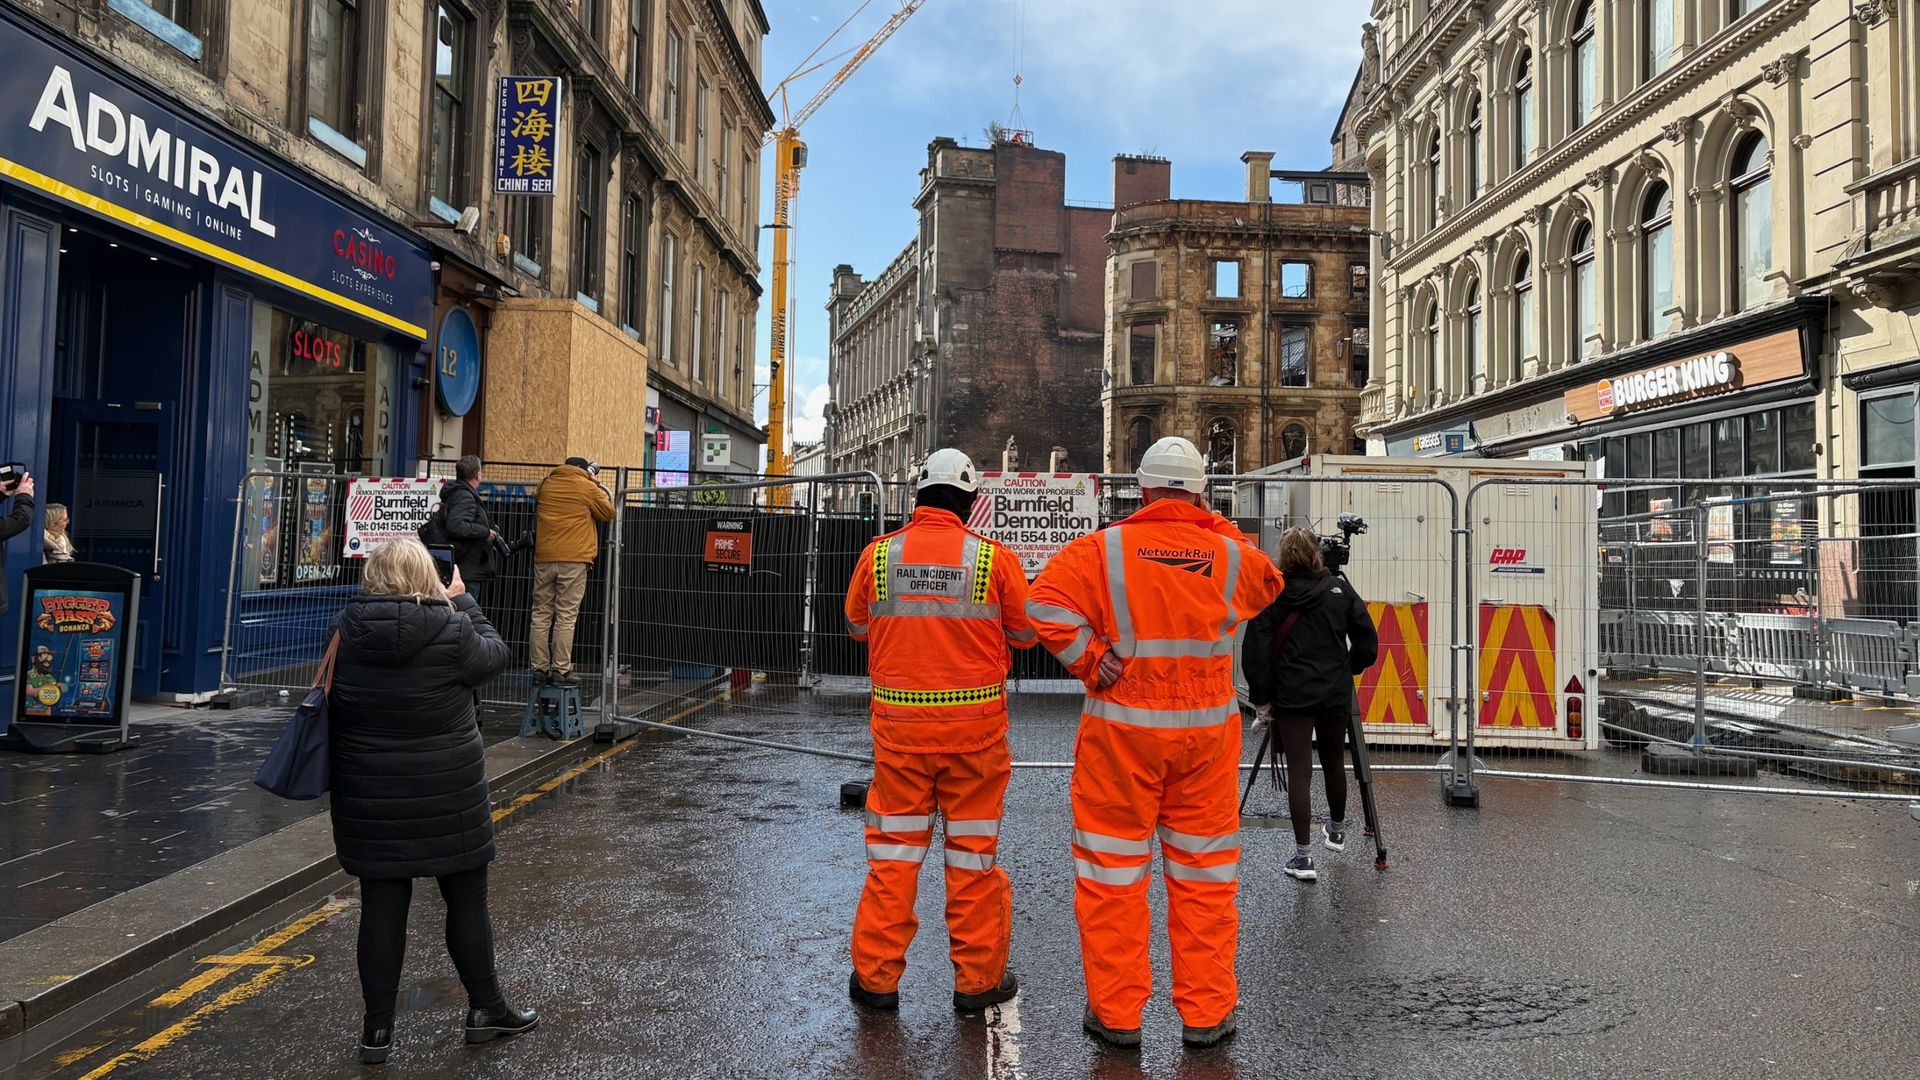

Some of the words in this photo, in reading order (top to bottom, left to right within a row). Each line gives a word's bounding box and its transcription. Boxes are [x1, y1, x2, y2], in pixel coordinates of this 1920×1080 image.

[499, 79, 507, 176] RESTAURANT
[509, 79, 553, 177] 四海楼
[28, 65, 276, 238] ADMIRAL
[498, 178, 528, 191] CHINA
[532, 178, 552, 191] SEA
[90, 164, 129, 192] SLOTS
[144, 189, 192, 219] GAMING
[205, 215, 242, 241] ONLINE
[332, 229, 397, 280] CASINO
[332, 270, 353, 288] SLOTS
[355, 280, 393, 305] EXPERIENCE
[293, 330, 341, 368] SLOTS
[441, 346, 457, 377] 12
[1613, 365, 1680, 407] BURGER
[1680, 352, 1730, 392] KING
[1418, 431, 1441, 449] GREGGS
[1004, 479, 1047, 487] CAUTION
[978, 487, 1012, 495] OLITION
[374, 496, 428, 508] Burnfield
[994, 495, 1074, 512] Burnfield
[374, 508, 432, 521] Demolitio
[994, 512, 1092, 529] Demolition
[354, 522, 369, 531] Tel:
[370, 522, 389, 531] 0141
[391, 522, 408, 531] 554
[411, 522, 422, 531] 80
[717, 521, 743, 530] WARNING
[714, 538, 734, 550] PRIME
[990, 531, 1018, 542] 0141
[1020, 531, 1047, 542] 554
[715, 549, 742, 560] SECURE
[1137, 547, 1215, 560] NetworkRail
[1489, 548, 1526, 564] GAP
[296, 565, 319, 579] OPEN
[322, 564, 340, 579] 24/7
[896, 568, 918, 579] RAIL
[920, 568, 963, 581] INCIDENT
[910, 580, 948, 591] OFFICER
[42, 595, 110, 614] BIGGER
[53, 610, 97, 625] BASS
[59, 624, 90, 633] BONANZA
